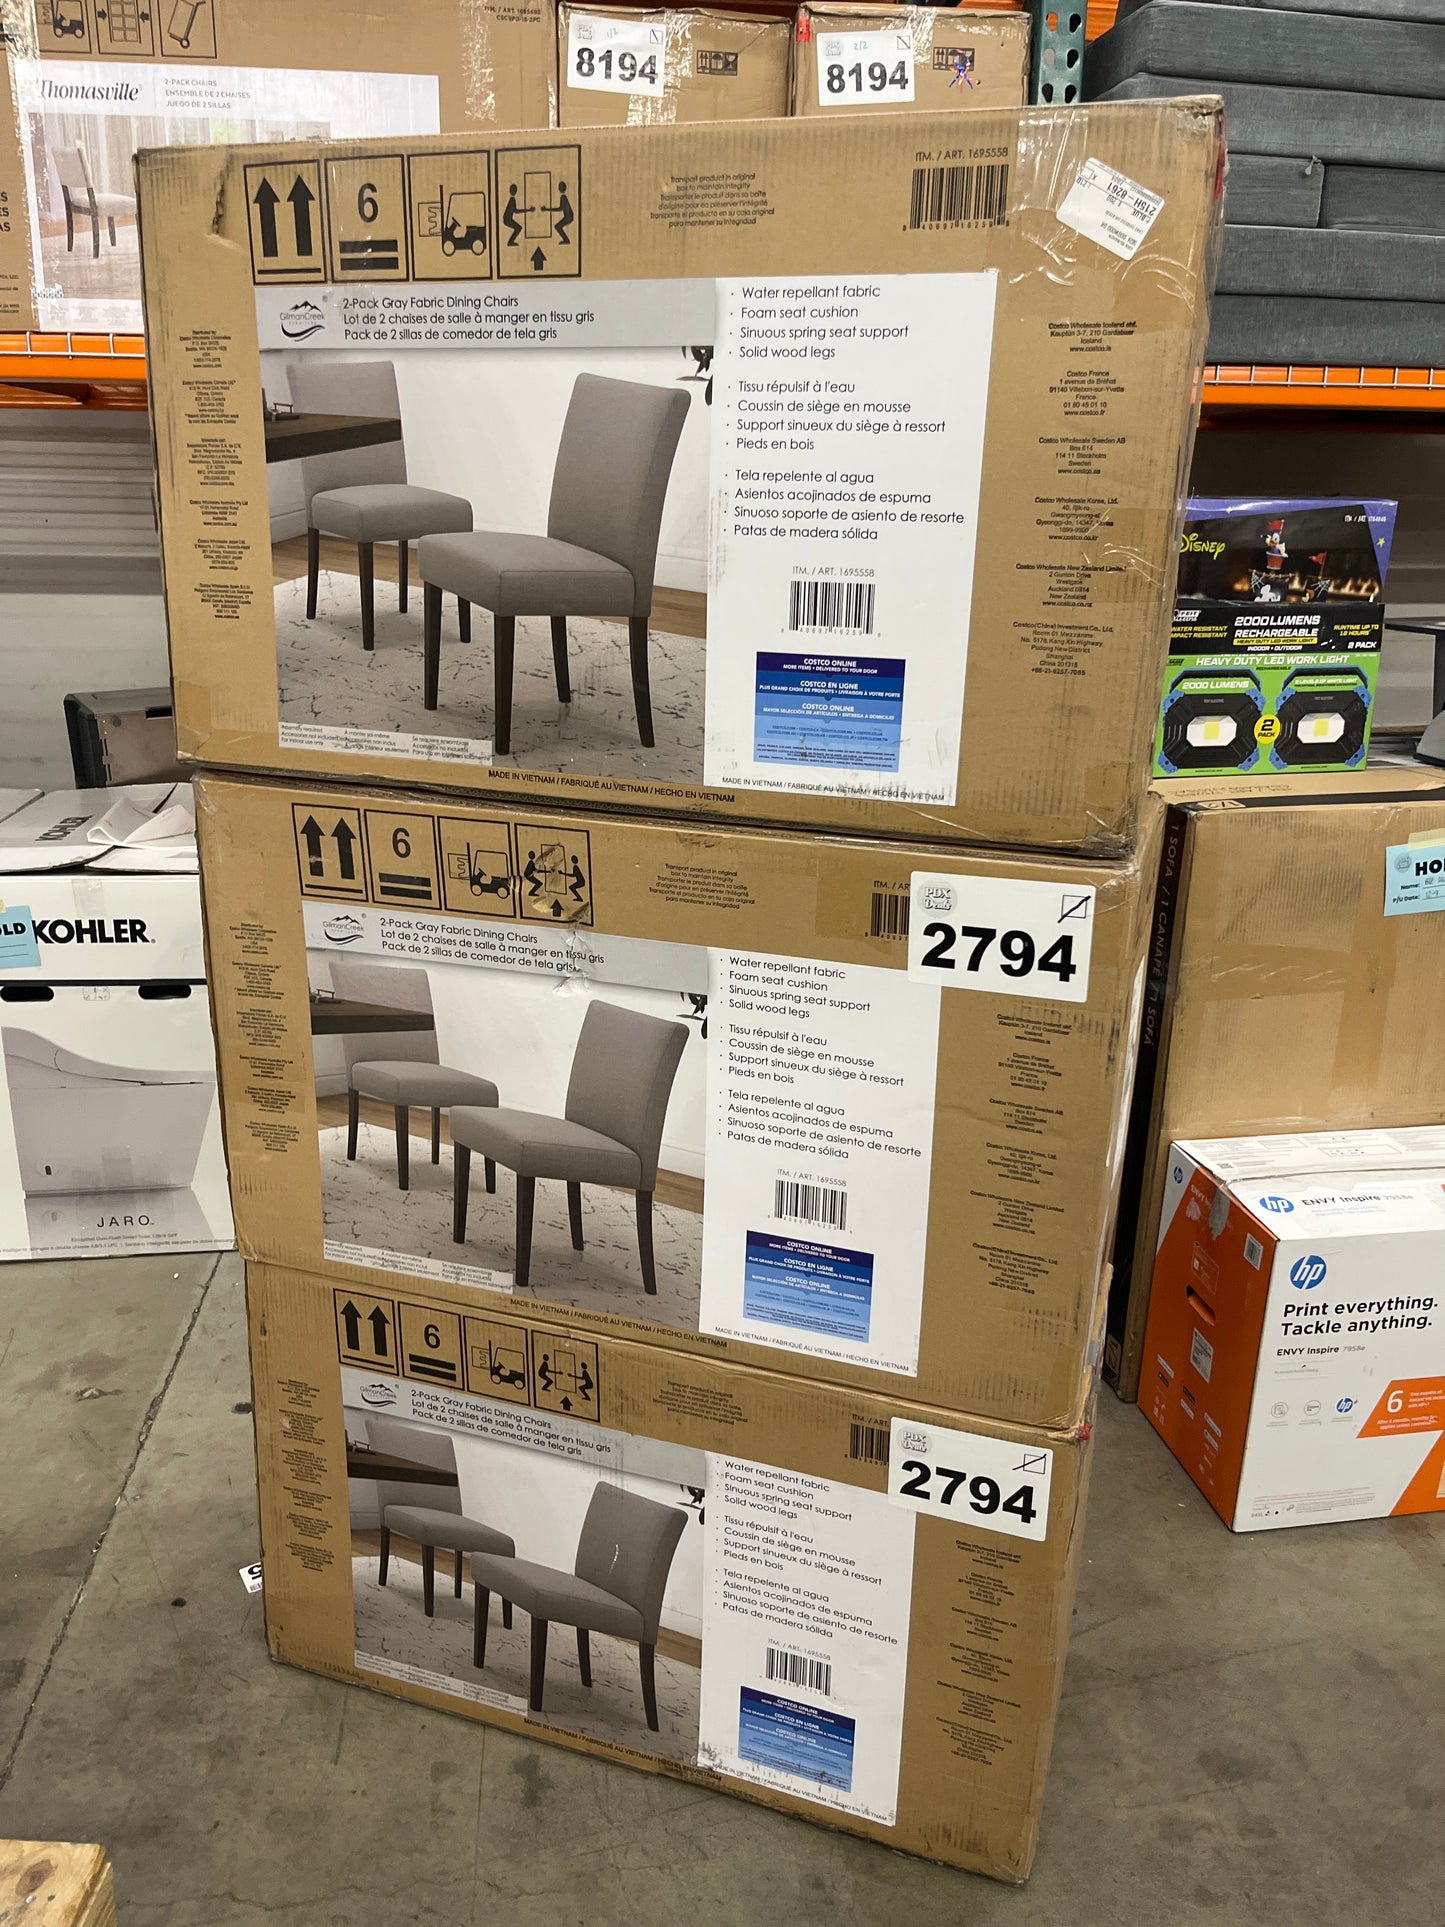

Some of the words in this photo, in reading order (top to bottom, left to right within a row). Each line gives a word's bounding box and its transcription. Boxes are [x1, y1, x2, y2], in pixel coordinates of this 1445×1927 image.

[576, 47, 659, 84] 8194
[827, 61, 908, 93] 8194
[40, 79, 139, 101] Thomasville
[357, 183, 378, 223] 6
[742, 286, 780, 299] Water
[782, 285, 839, 301] repellant
[843, 284, 881, 298] fabric
[342, 297, 379, 310] 2-Pack
[381, 297, 408, 311] Gray
[410, 296, 445, 309] Fabric
[446, 296, 482, 310] Dining
[483, 295, 519, 308] Chairs
[343, 313, 359, 325] Lot
[362, 313, 377, 325] de
[379, 312, 386, 325] 2
[388, 312, 428, 325] chaises
[429, 312, 445, 324] de
[447, 312, 472, 324] salle
[474, 311, 483, 324] à
[484, 313, 530, 326] manger
[532, 313, 547, 323] en
[550, 310, 573, 323] tissu
[575, 310, 595, 325] gris
[741, 307, 777, 319] Foam
[779, 306, 806, 319] seat
[809, 305, 859, 319] cushion
[344, 328, 371, 341] Pack
[373, 328, 388, 341] de
[390, 328, 397, 340] 2
[398, 328, 423, 340] sillas
[424, 328, 440, 340] de
[442, 327, 494, 340] comedor
[495, 327, 512, 340] de
[514, 327, 536, 340] tela
[538, 327, 558, 342] gris
[740, 326, 786, 339] Sinuous
[788, 325, 827, 341] spring
[829, 325, 857, 338] seat
[859, 325, 909, 340] support
[739, 345, 768, 358] Solid
[770, 345, 808, 358] wood
[810, 345, 836, 361] legs
[735, 469, 760, 481] Tela
[762, 470, 823, 484] repelente
[825, 471, 837, 483] al
[839, 473, 874, 486] agua
[734, 487, 785, 500] Asientos
[787, 489, 856, 503] acojinados
[858, 490, 876, 503] de
[879, 493, 931, 505] espuma
[734, 505, 780, 519] Sinuoso
[781, 508, 828, 521] soporte
[831, 508, 848, 521] de
[851, 509, 897, 522] asiento
[900, 510, 918, 523] de
[920, 511, 965, 524] resorte
[734, 524, 767, 537] Patas
[769, 525, 787, 537] de
[789, 526, 839, 539] madera
[841, 527, 878, 540] sólida
[839, 568, 876, 577] 1695558
[1234, 615, 1270, 627] 2000
[1269, 615, 1321, 626] LUMENS
[1234, 628, 1319, 638] RECHARGEABLE
[1355, 641, 1377, 649] PACK
[803, 658, 831, 666] COSTCO
[831, 659, 857, 668] ONLINE
[1195, 657, 1233, 666] HEAVY
[1233, 656, 1263, 666] DUTY
[1263, 656, 1285, 665] LED
[1286, 655, 1319, 665] WORK
[1319, 654, 1350, 664] LIGHT
[1182, 681, 1209, 689] 2000
[1209, 681, 1250, 689] LUMENS
[1261, 719, 1274, 731] 2
[392, 828, 411, 859] 6
[1165, 836, 1178, 877] SOFA
[1415, 858, 1445, 877] HO
[924, 887, 951, 899] PDX
[31, 919, 150, 944] KOHLER
[379, 917, 413, 930] 2-Pack
[415, 921, 439, 934] Gray
[441, 924, 472, 937] Fabric
[473, 927, 505, 942] Dining
[506, 931, 538, 944] Chairs
[921, 922, 1077, 982] 2794
[728, 1023, 751, 1035] Tissu
[752, 1027, 790, 1041] répulsif
[791, 1032, 799, 1042] à
[801, 1034, 827, 1046] l'eau
[728, 1065, 756, 1078] Pieds
[757, 1071, 771, 1080] en
[773, 1072, 794, 1084] bois
[1261, 1196, 1293, 1214] hp
[1302, 1196, 1337, 1206] ENVY
[1340, 1194, 1381, 1203] Inspire
[97, 1215, 150, 1228] JARO
[1292, 1255, 1326, 1290] hp
[1283, 1302, 1329, 1318] Print
[1334, 1295, 1438, 1315] everything.
[1281, 1319, 1342, 1336] Tackle
[1347, 1314, 1432, 1334] anything.
[424, 1324, 441, 1349] 6
[1276, 1347, 1305, 1356] ENVY
[1307, 1345, 1340, 1355] Inspire
[410, 1389, 441, 1403] 2-Pack
[442, 1396, 464, 1409] Gray
[465, 1401, 493, 1415] Fabric
[494, 1408, 522, 1423] Dining
[523, 1415, 552, 1429] Chairs
[1387, 1390, 1404, 1413] 6
[903, 1431, 926, 1443] PDX
[900, 1460, 1037, 1524] 2794
